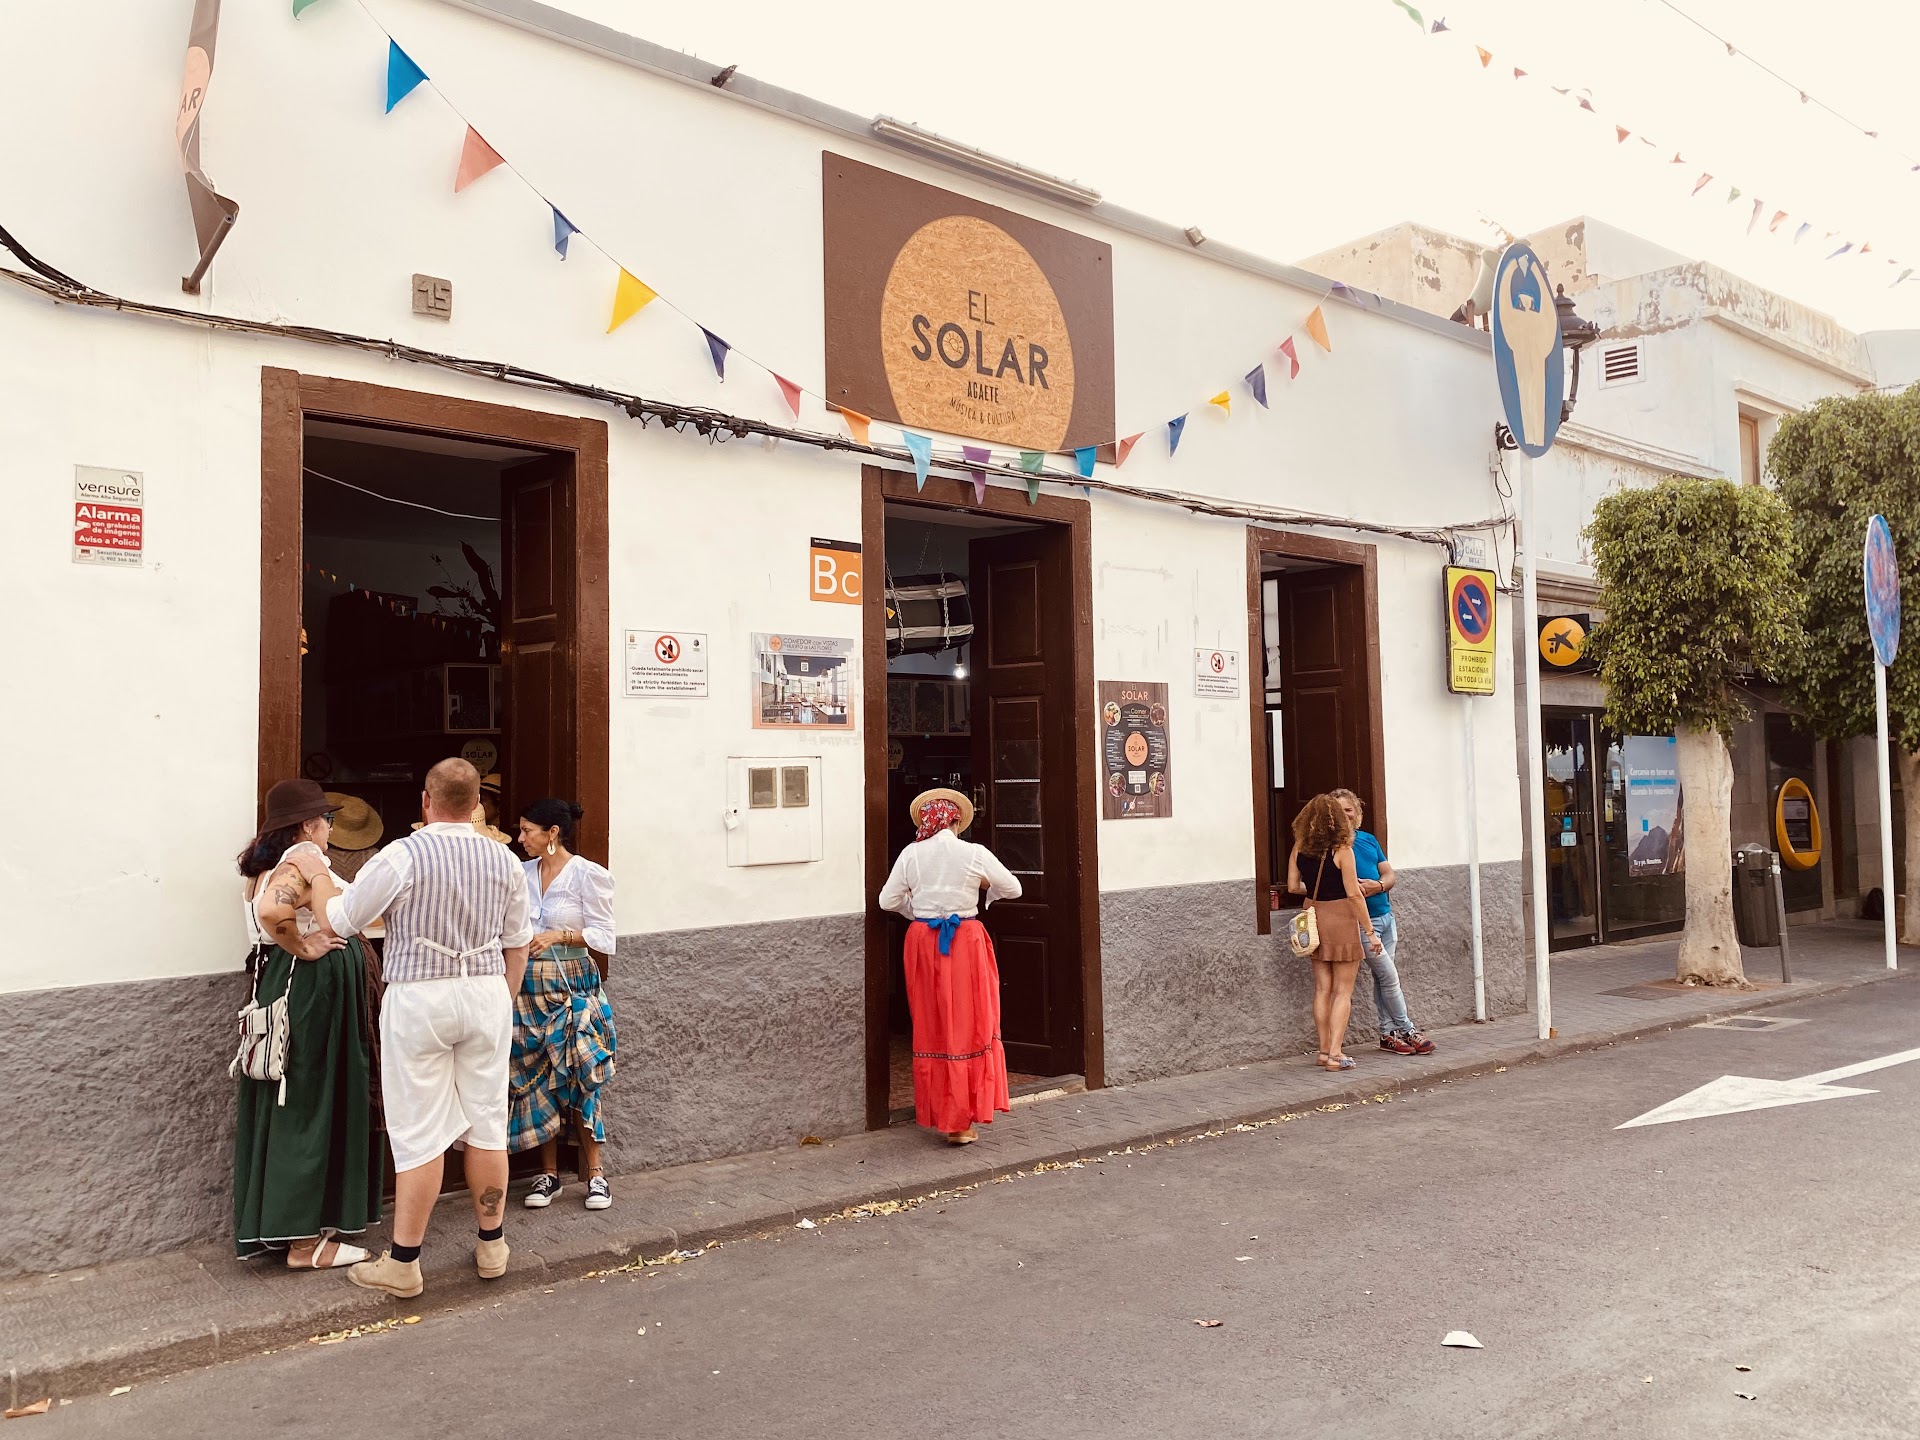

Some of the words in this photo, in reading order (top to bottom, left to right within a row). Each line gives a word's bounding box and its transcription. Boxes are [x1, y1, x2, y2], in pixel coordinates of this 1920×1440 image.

[418, 281, 450, 312] 15
[968, 289, 995, 326] EL
[911, 313, 1050, 390] SOLAR
[967, 381, 1000, 404] AGAETE
[979, 411, 985, 424] &
[987, 410, 1017, 426] CULTURA
[78, 482, 141, 497] verisure
[77, 505, 141, 523] Alarma
[104, 527, 140, 537] imágenes
[106, 521, 140, 531] grabación
[79, 534, 103, 544] Aviso
[1465, 545, 1484, 557] CALLE
[814, 554, 860, 598] Bc
[783, 637, 812, 645] COMEDOR
[1461, 655, 1487, 664] PROHIBIDO
[1459, 665, 1489, 673] ESTACIONAR
[1121, 690, 1149, 701] SOLAR
